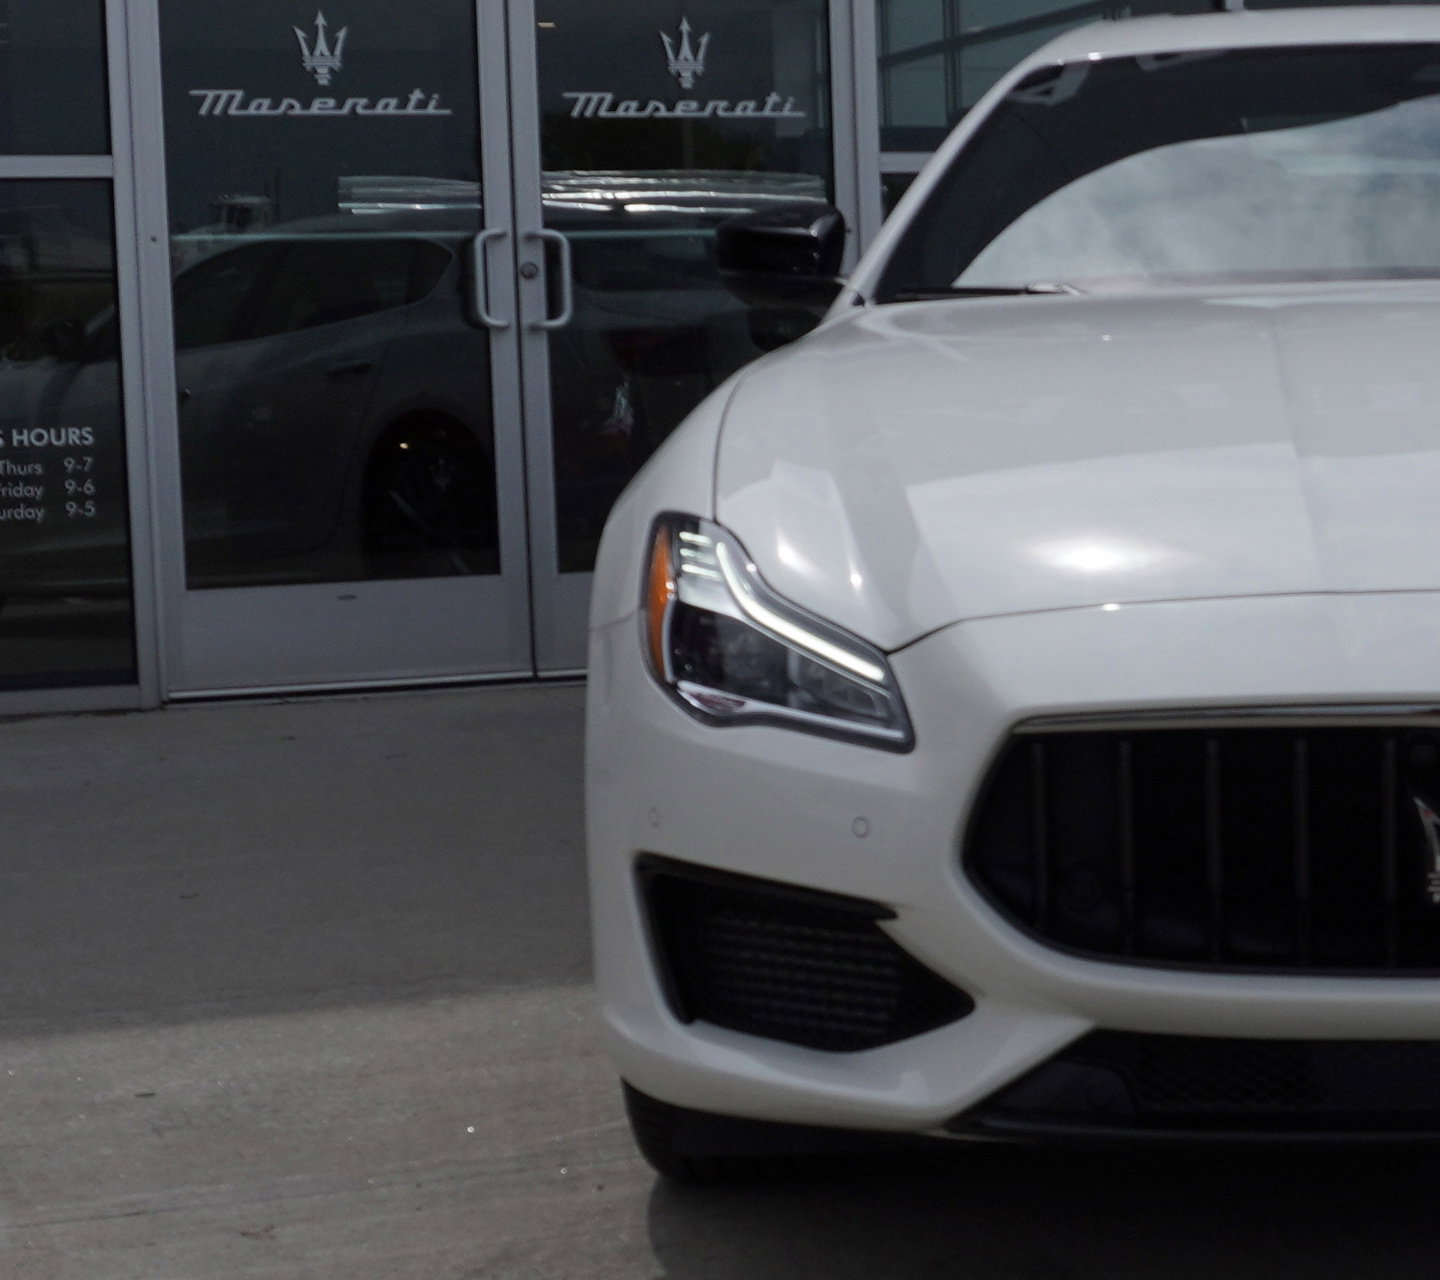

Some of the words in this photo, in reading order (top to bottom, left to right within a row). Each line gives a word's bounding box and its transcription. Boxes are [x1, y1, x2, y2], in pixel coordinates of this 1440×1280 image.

[188, 87, 452, 117] Maserati
[561, 91, 806, 118] Maserati
[11, 426, 95, 448] HOURS
[63, 456, 94, 473] 9-7
[64, 478, 96, 496] 9-6
[65, 500, 96, 518] 9-5
